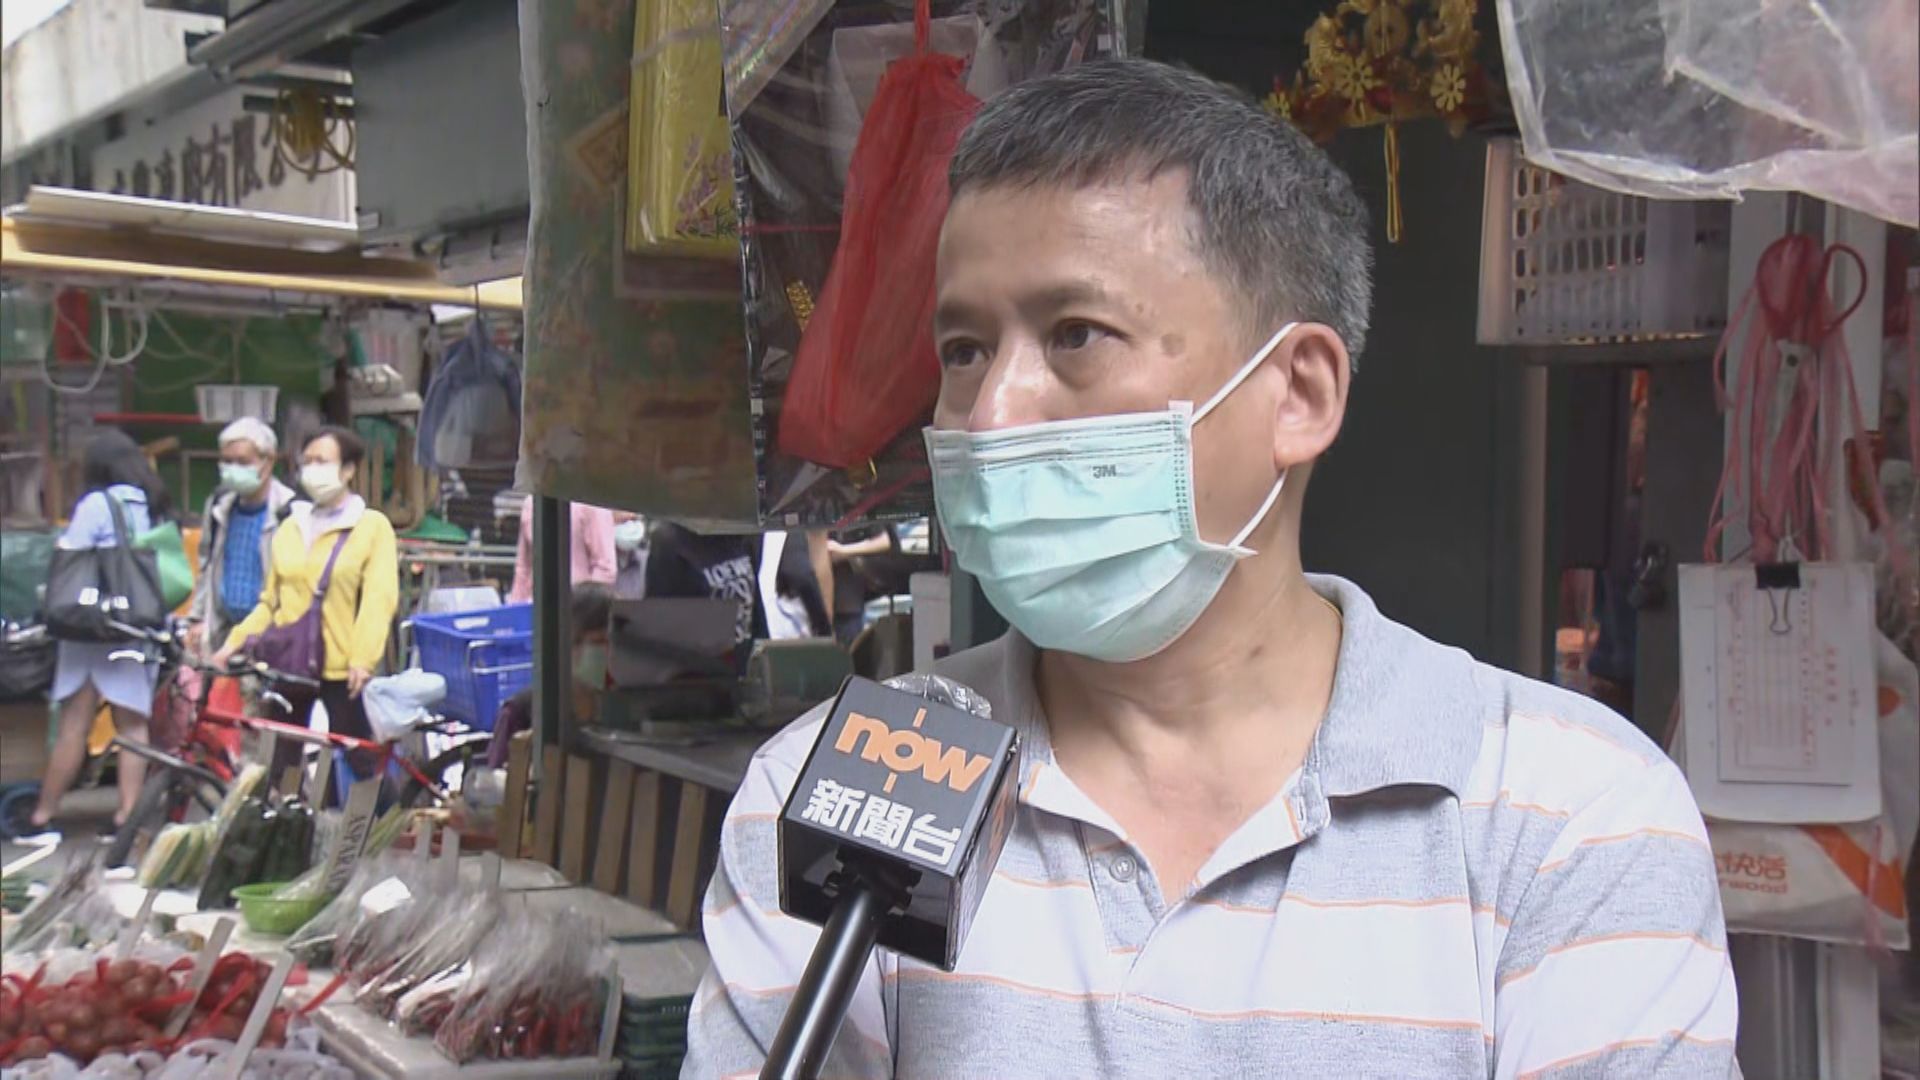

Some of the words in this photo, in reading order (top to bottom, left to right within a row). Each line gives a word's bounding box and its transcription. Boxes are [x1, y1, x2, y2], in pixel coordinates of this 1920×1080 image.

[1092, 464, 1117, 479] 3M
[834, 707, 993, 793] now
[801, 778, 962, 865] 新聞台
